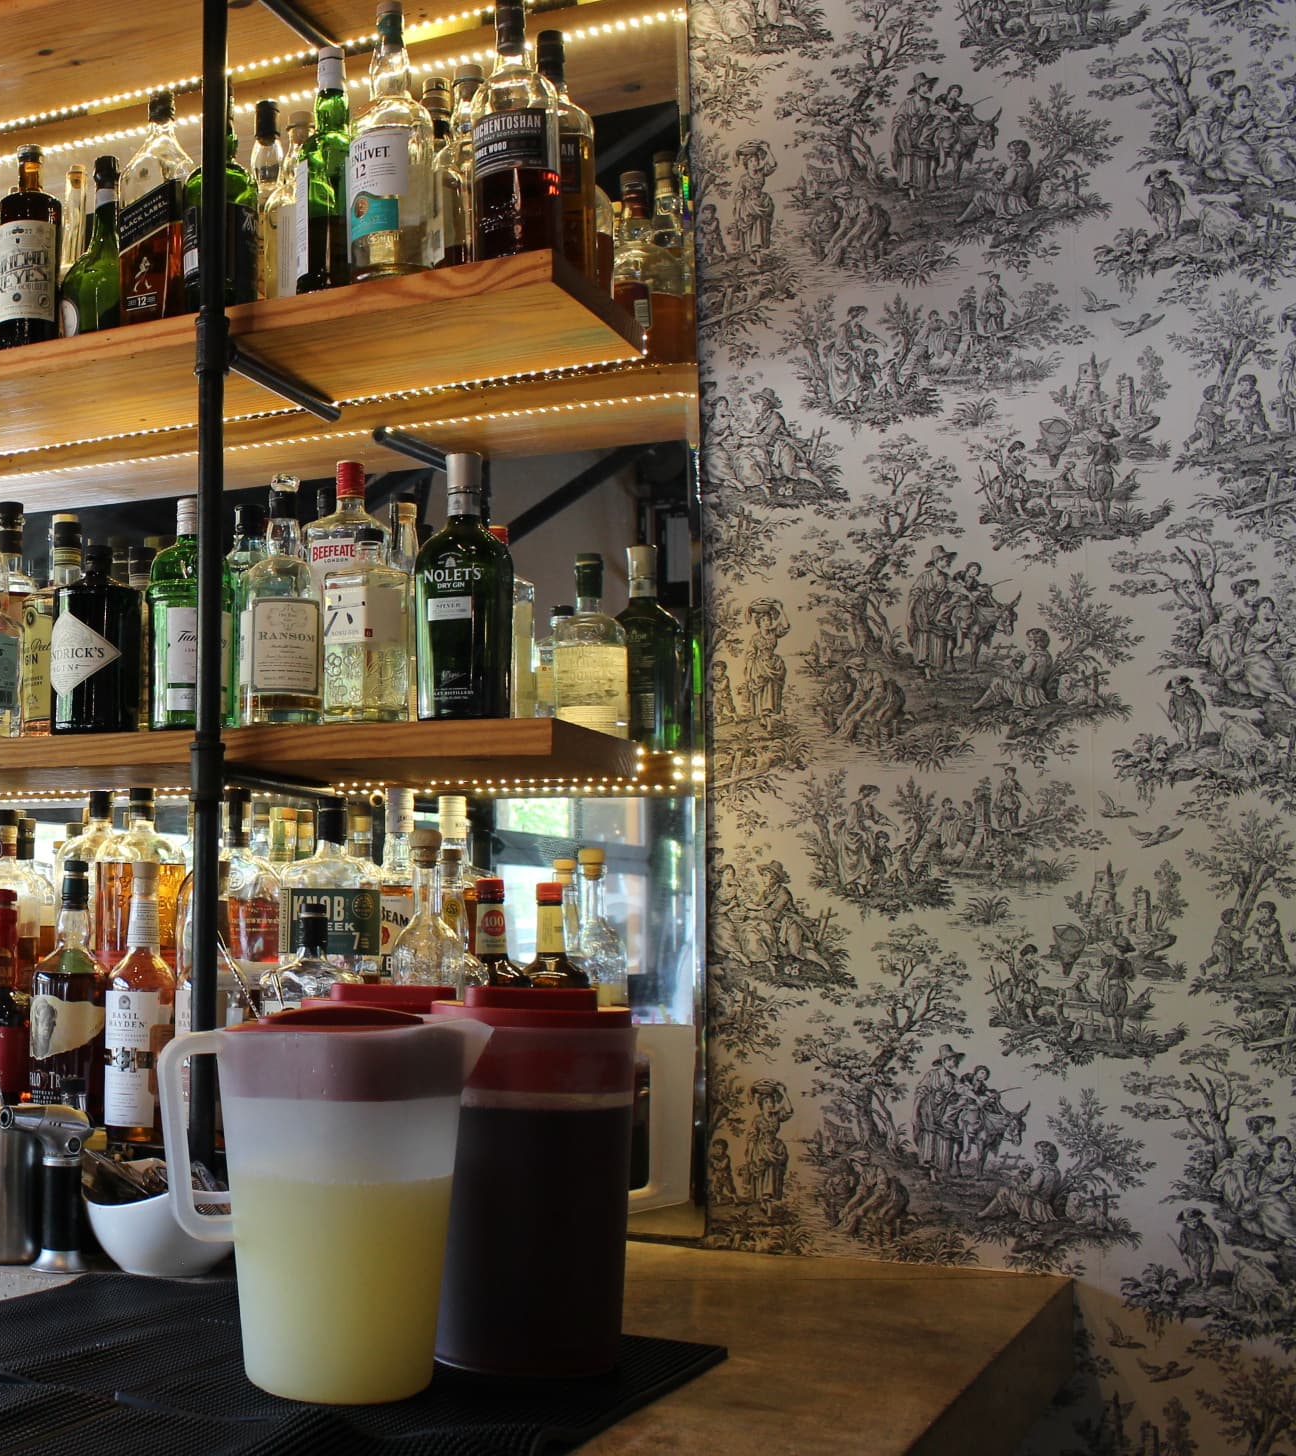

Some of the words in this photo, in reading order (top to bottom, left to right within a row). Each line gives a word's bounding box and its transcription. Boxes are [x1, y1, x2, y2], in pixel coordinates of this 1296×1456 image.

[354, 141, 367, 154] THE
[474, 148, 488, 159] HREE
[489, 141, 508, 152] WOOD
[355, 163, 367, 179] 12
[119, 216, 144, 233] BLACK
[144, 200, 168, 217] LABEL
[137, 296, 147, 306] 12
[312, 543, 357, 562] BEEFEATE
[424, 567, 482, 584] NOLET'S
[452, 580, 465, 588] GIN
[257, 632, 315, 642] RANSOM
[25, 653, 39, 666] GIN
[484, 914, 504, 927] 100
[352, 932, 360, 950] 7
[379, 955, 393, 970] YE
[112, 1012, 140, 1020] BASIL
[108, 1021, 145, 1029] HAYDEN
